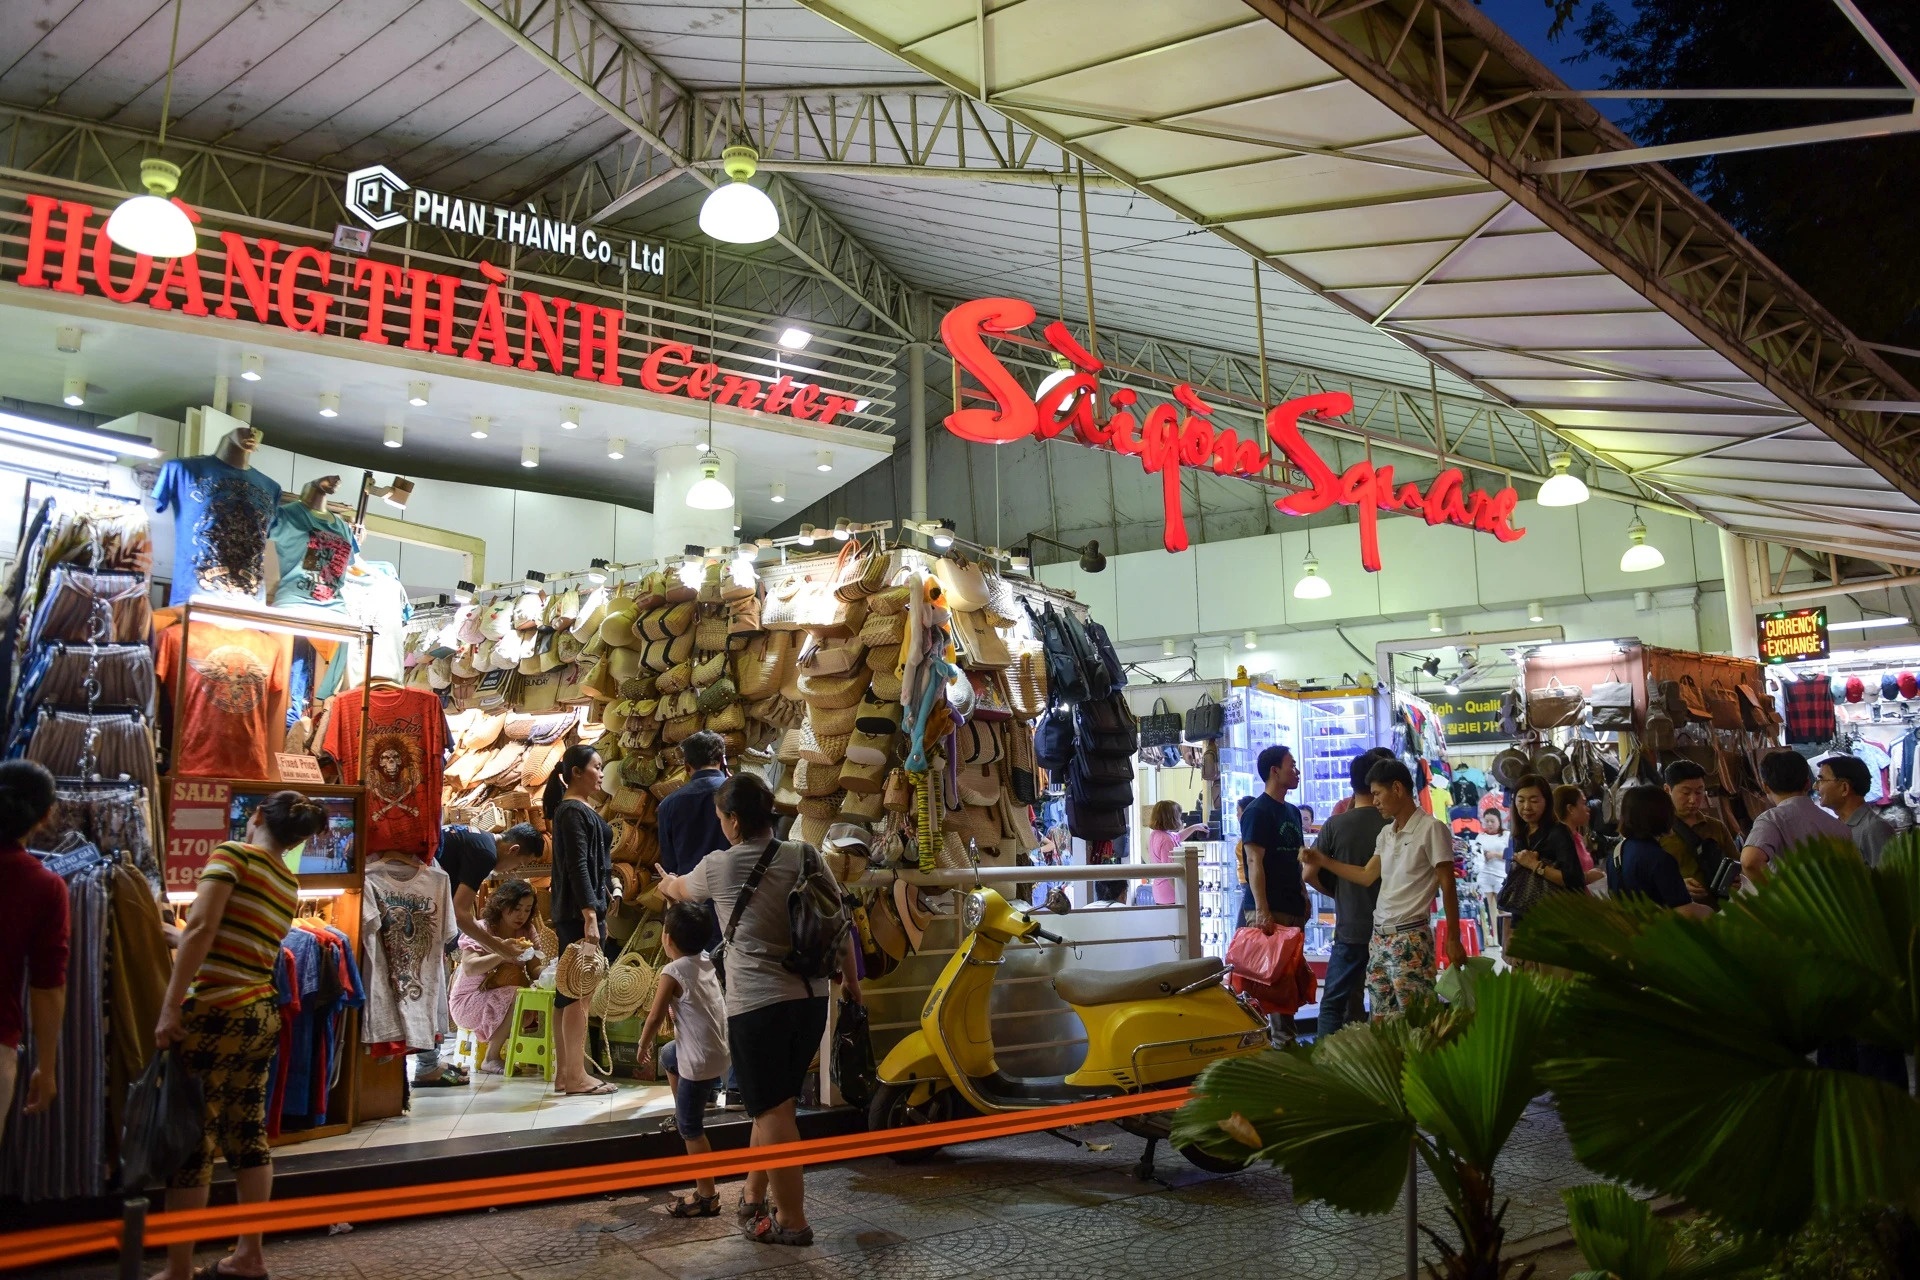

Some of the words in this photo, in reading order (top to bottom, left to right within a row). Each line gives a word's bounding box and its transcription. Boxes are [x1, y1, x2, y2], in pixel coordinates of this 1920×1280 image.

[414, 189, 486, 236] PHAN
[494, 203, 577, 256] THÀNH
[631, 239, 665, 276] Ltd
[353, 258, 625, 387] THÀNH
[640, 343, 857, 425] Center
[1266, 391, 1527, 572] Square
[1766, 611, 1818, 637] CURRENCY
[1767, 635, 1820, 657] EXCHANGE
[174, 783, 229, 802] SALE
